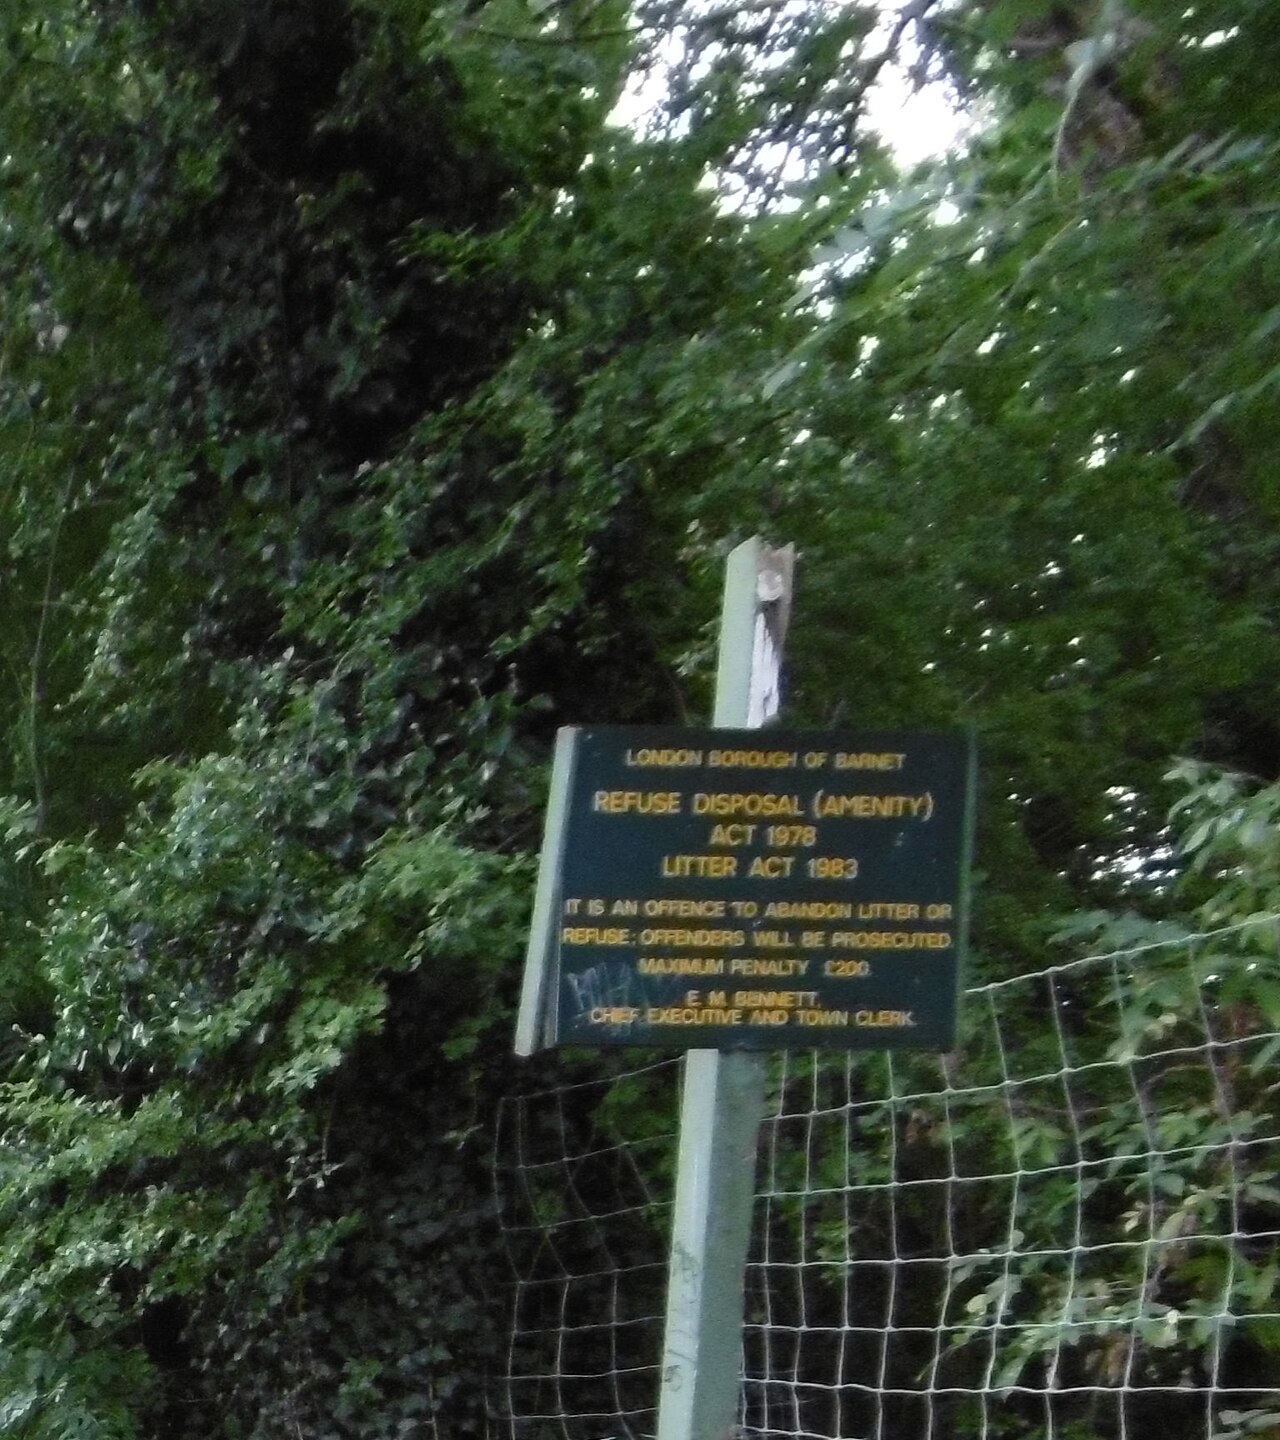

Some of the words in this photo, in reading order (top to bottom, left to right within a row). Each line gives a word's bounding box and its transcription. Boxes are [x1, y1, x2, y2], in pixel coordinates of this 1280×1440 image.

[626, 748, 703, 767] LONDON
[709, 750, 796, 768] BOROUGH
[805, 753, 827, 768] OF
[836, 753, 906, 770] BARNET
[593, 791, 680, 813] REFUSE
[693, 792, 804, 815] DISPOSAL
[814, 790, 934, 821] (AMENITY)
[710, 824, 756, 845] ACT
[767, 825, 816, 846] 1978
[662, 857, 737, 877] LITTER
[750, 858, 794, 878] ACT
[807, 858, 858, 879] 1983
[565, 899, 581, 914] IT
[588, 899, 605, 914] IS
[612, 900, 637, 915] AN
[645, 900, 725, 916] OFFENCE
[731, 902, 757, 918] TO
[765, 902, 852, 918] ABANDON
[859, 904, 919, 919] LITTER
[926, 904, 952, 919] OR
[640, 930, 745, 946] OFFENDERS
[754, 931, 794, 946] WILL
[801, 932, 825, 947] BE
[639, 958, 724, 974] MAXIMUM
[731, 960, 810, 975] PENALTY
[591, 1008, 640, 1023] CHIEF
[648, 1008, 742, 1024] EXECUTIVE
[751, 1010, 788, 1025] AND
[796, 1011, 848, 1026] TOWN
